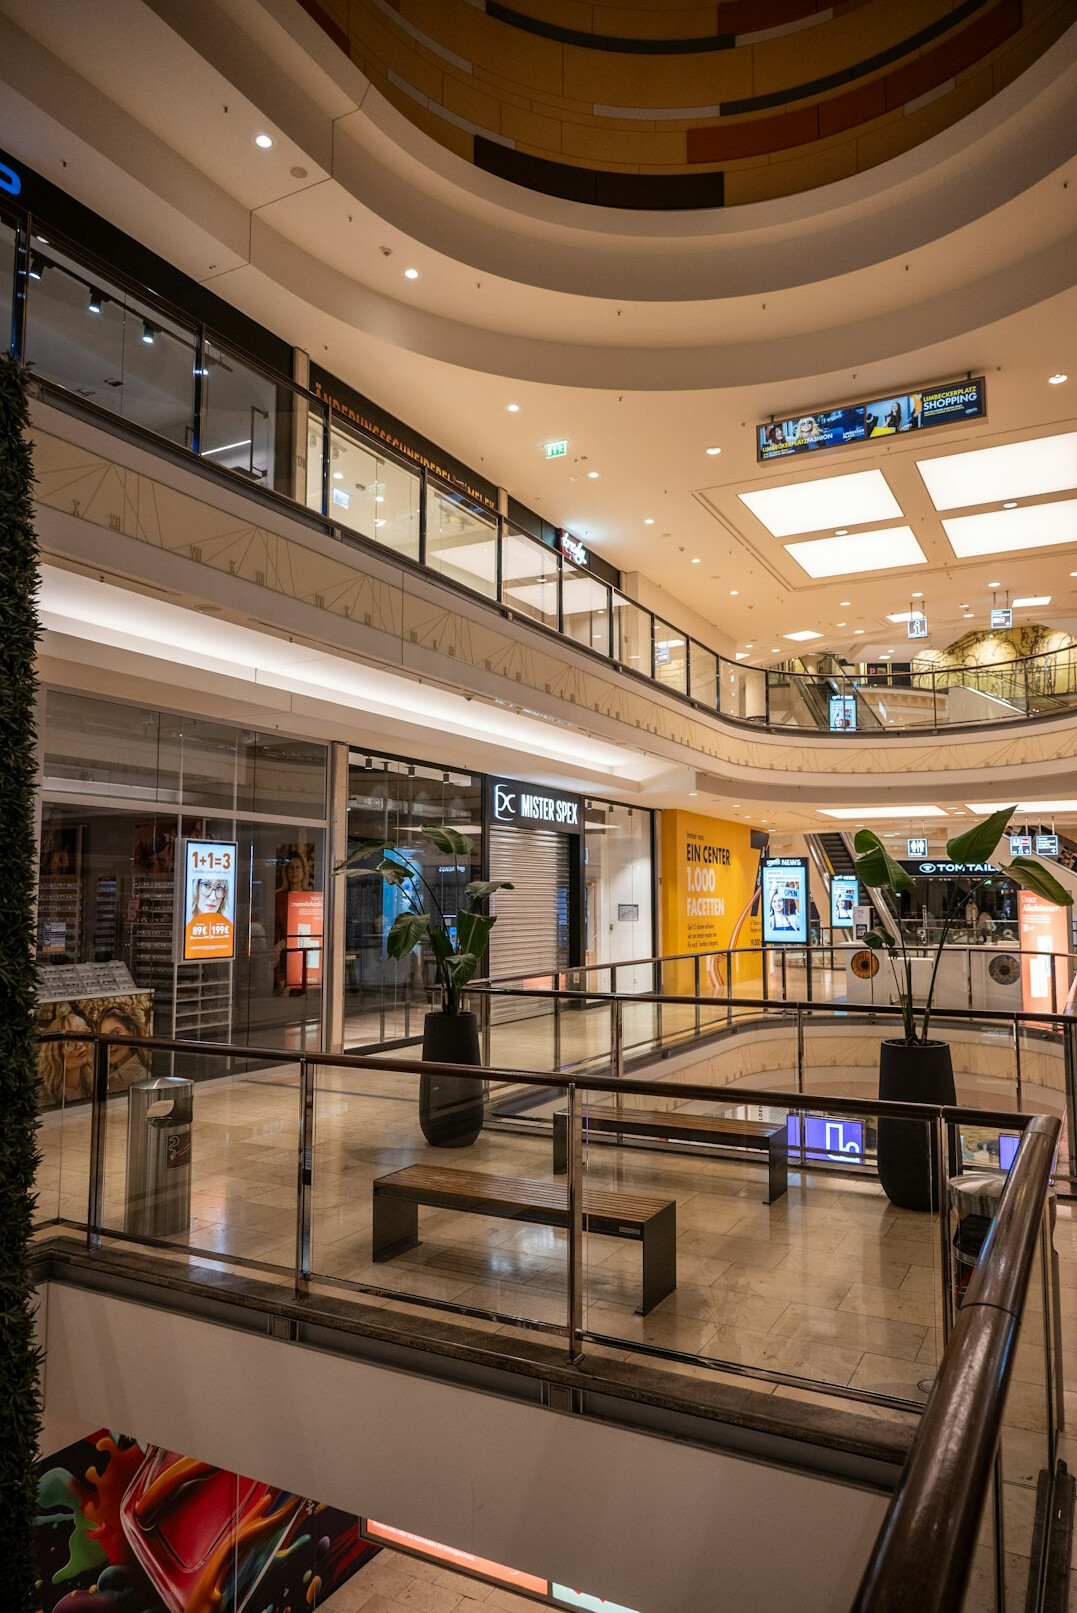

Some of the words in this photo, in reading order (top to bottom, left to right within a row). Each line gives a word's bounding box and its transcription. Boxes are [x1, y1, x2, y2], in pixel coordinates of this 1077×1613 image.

[923, 386, 977, 402] LIMBECKERPLATZ
[923, 392, 978, 411] SHOPPING
[520, 794, 555, 821] MISTER
[555, 800, 578, 825] SPEX
[686, 843, 701, 862] EIN
[702, 845, 731, 866] CENTER
[781, 858, 802, 866] NEWS
[936, 863, 965, 872] TOM
[686, 866, 716, 892] 1.000
[784, 889, 798, 898] OPEN
[686, 898, 724, 916] FACETTEN
